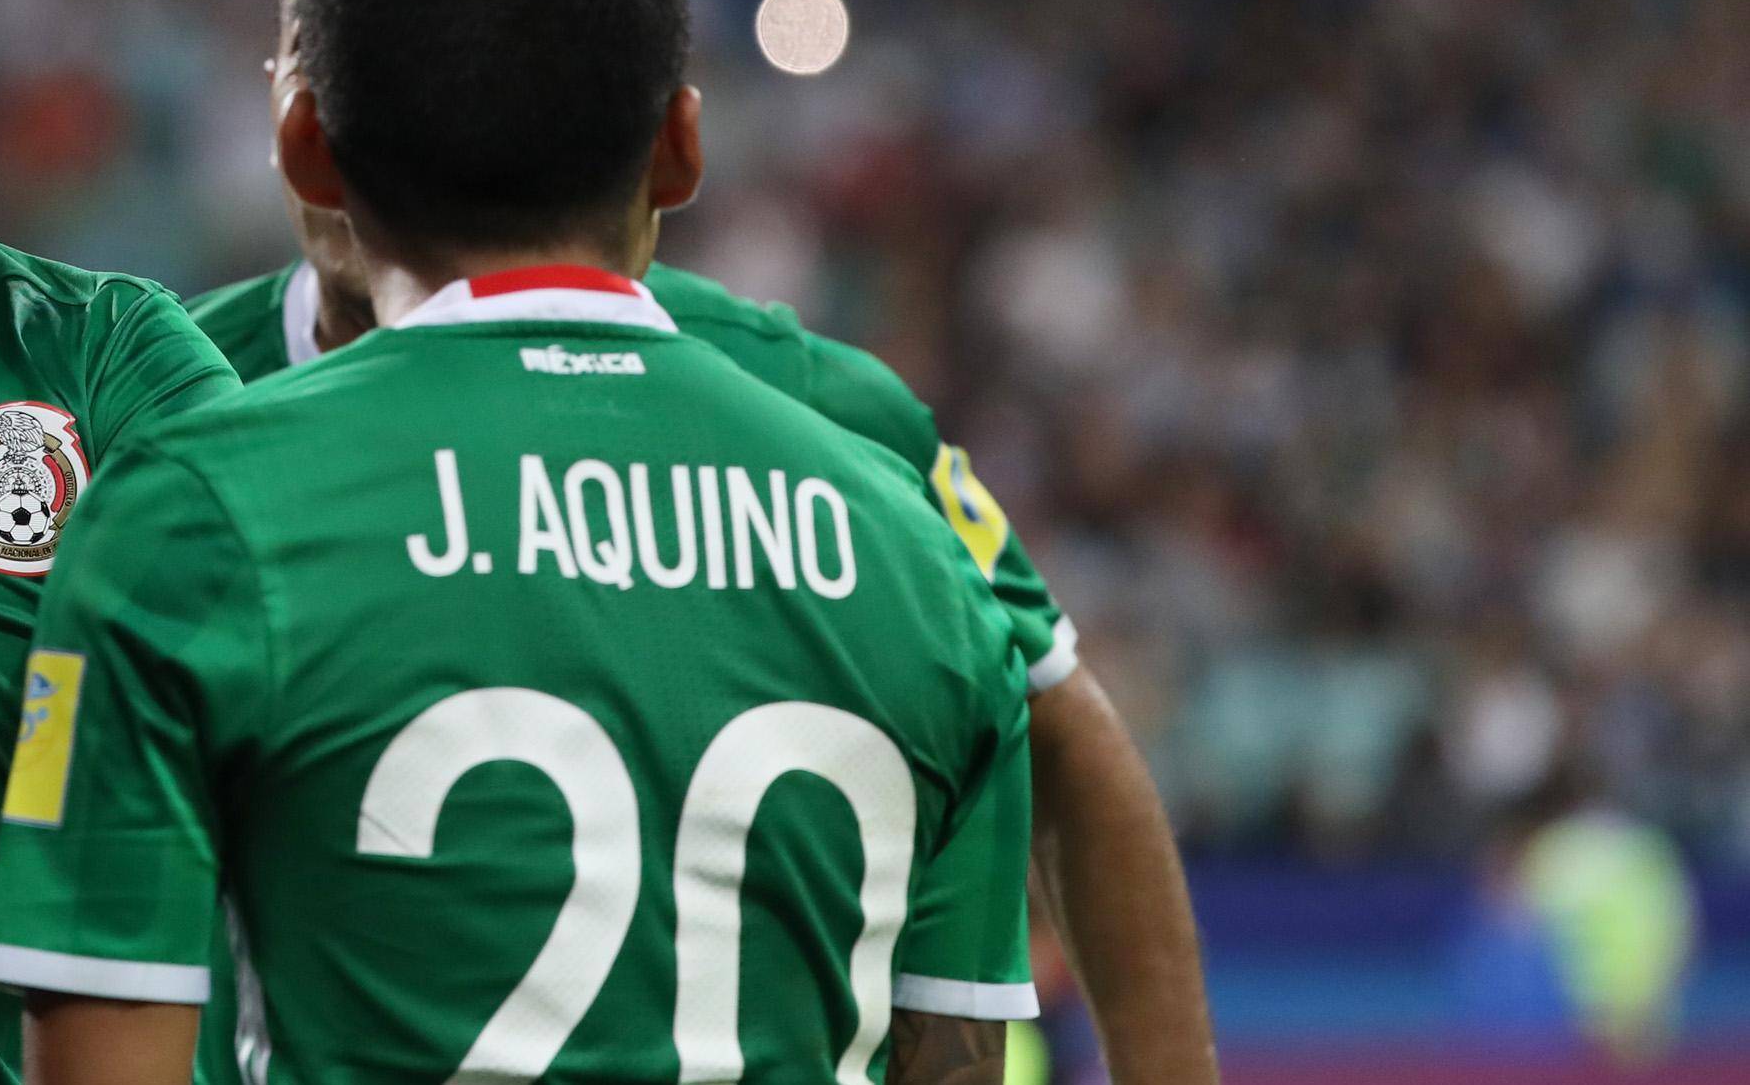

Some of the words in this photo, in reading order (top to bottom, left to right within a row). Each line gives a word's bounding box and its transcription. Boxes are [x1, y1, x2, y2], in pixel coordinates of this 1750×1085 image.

[406, 449, 493, 577] J.
[518, 454, 857, 599] AQUINO
[356, 686, 917, 1085] 20
